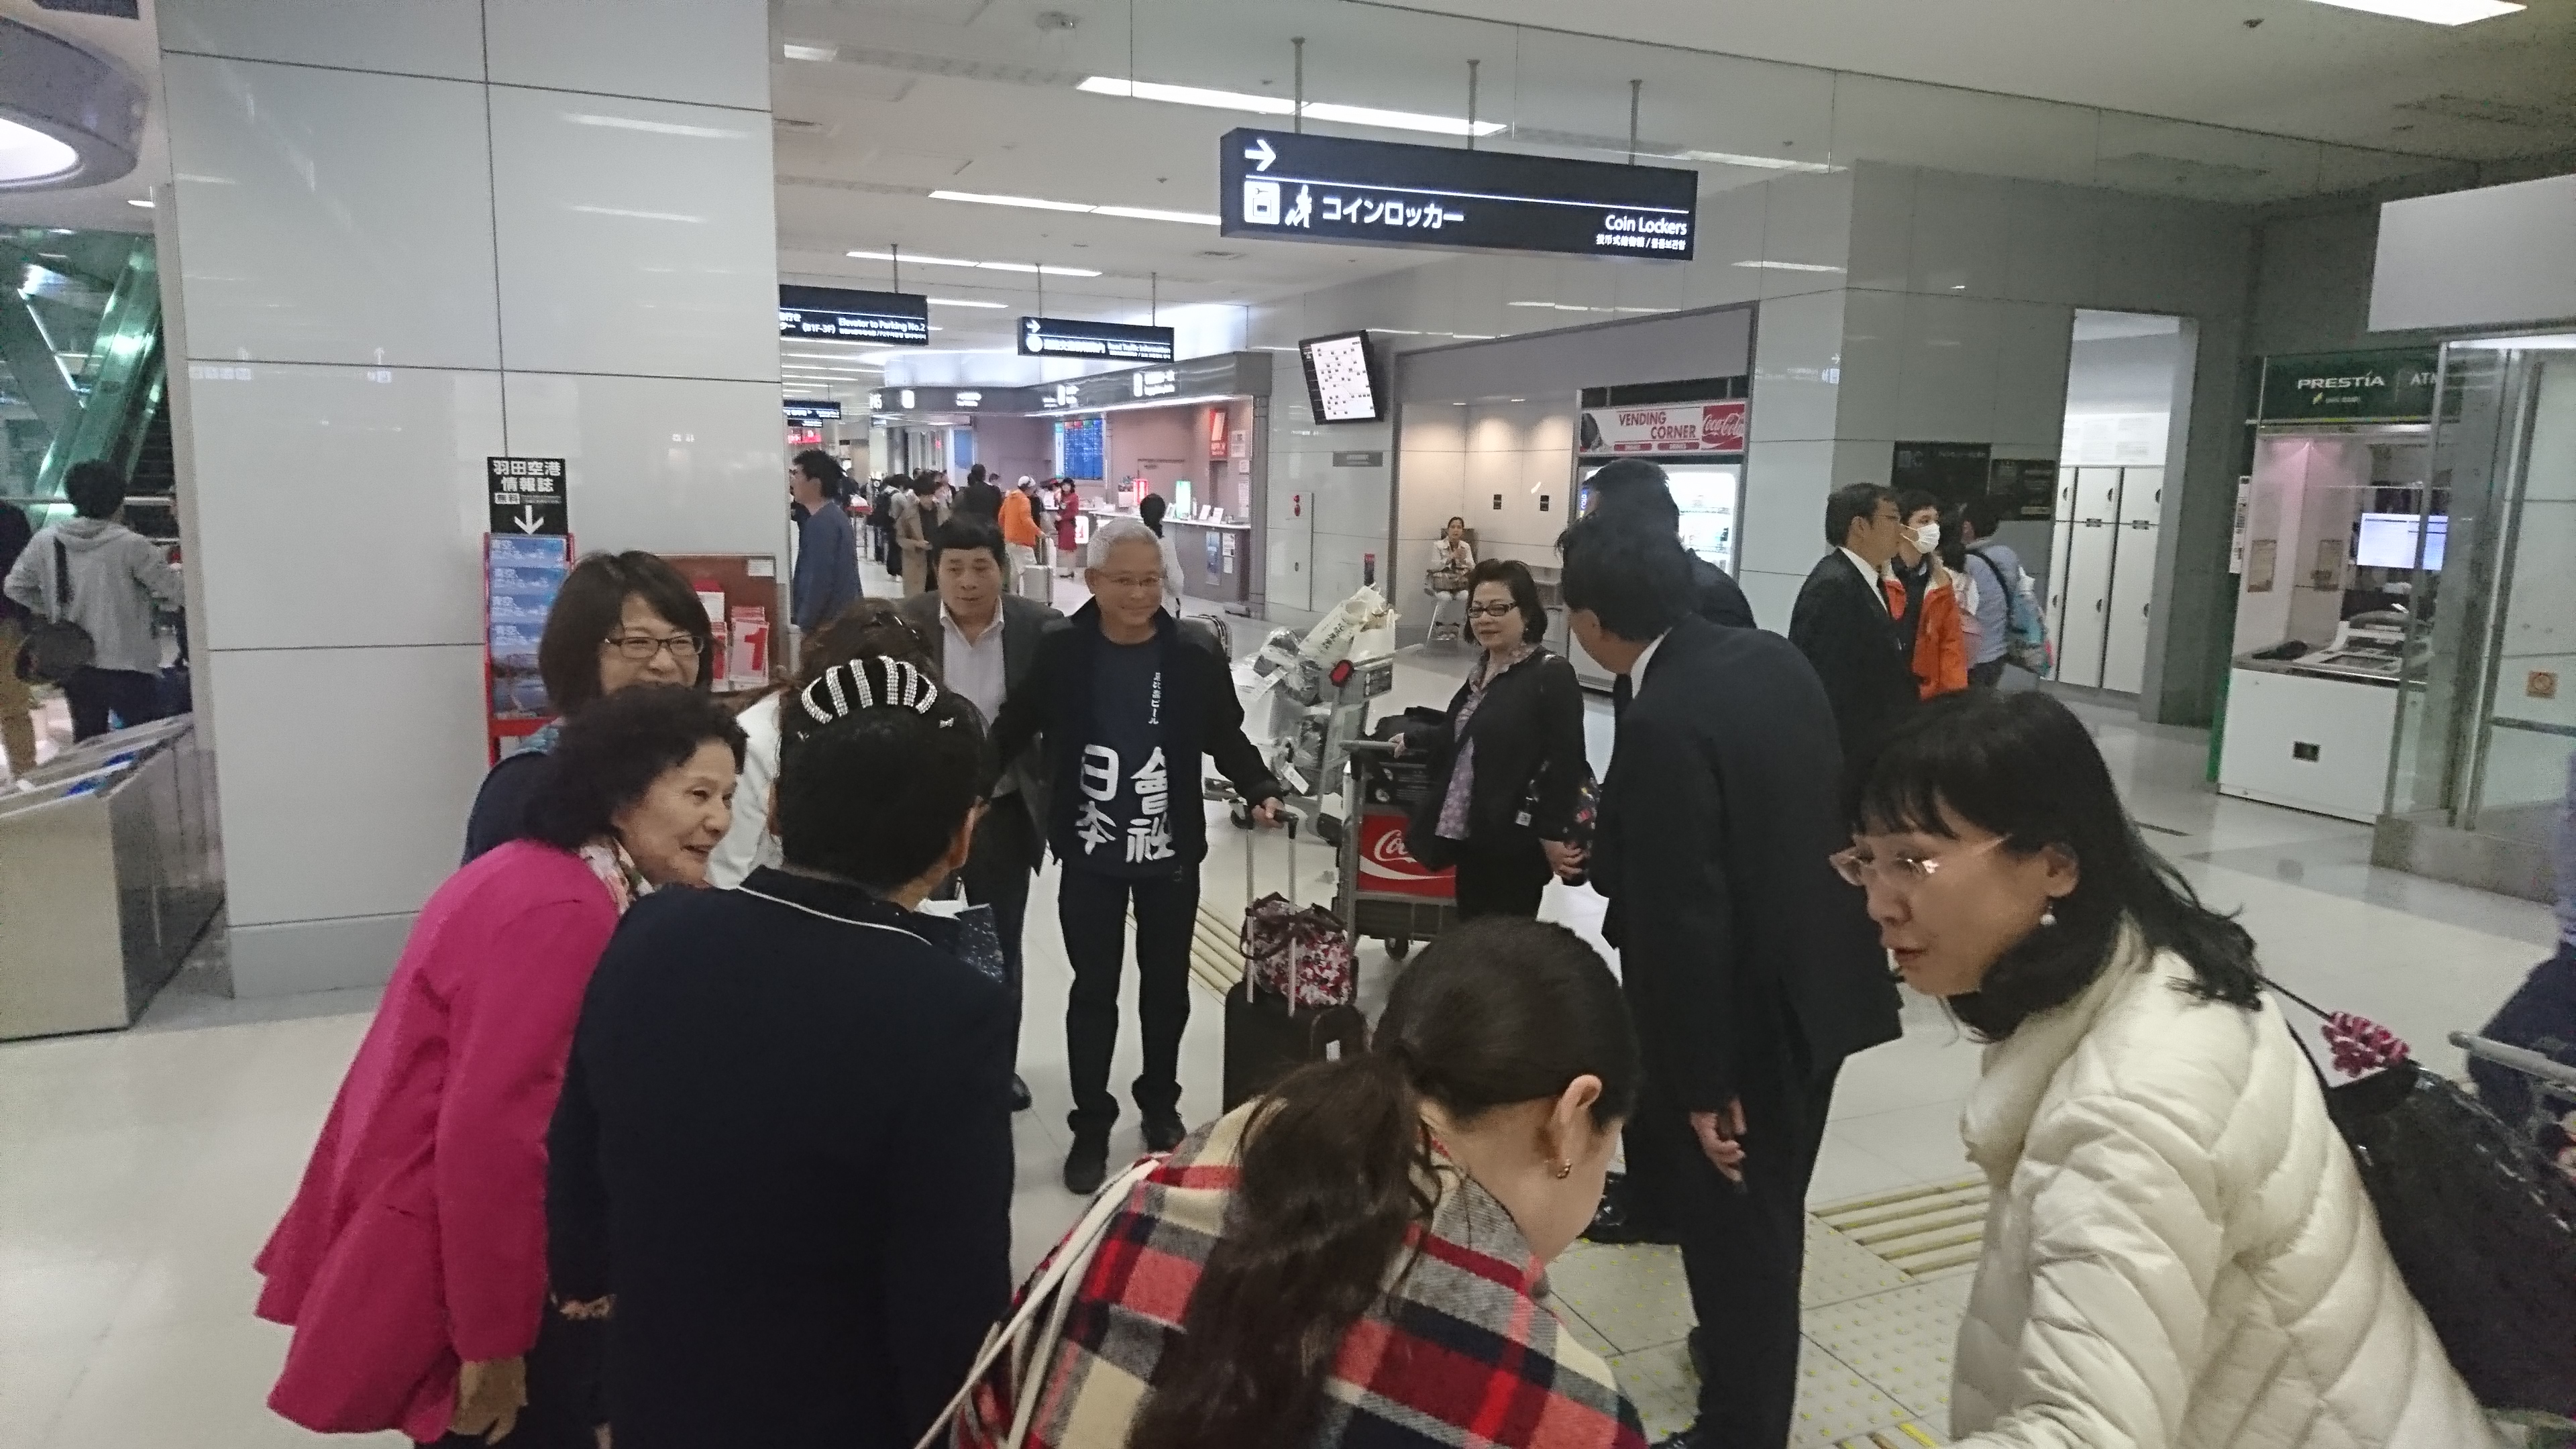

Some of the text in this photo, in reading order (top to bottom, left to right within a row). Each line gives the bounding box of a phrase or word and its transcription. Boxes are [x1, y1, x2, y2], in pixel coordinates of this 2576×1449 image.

[1322, 197, 1464, 229] コインロッカー
[1605, 214, 1687, 235] Coin Lockers
[839, 317, 868, 328] Elevator
[870, 320, 878, 329] to
[879, 321, 907, 332] Parking
[908, 323, 926, 332] No.2
[1619, 412, 1667, 426] VENDING
[1650, 425, 1697, 439] CORNER
[493, 460, 561, 476] 羽田空港
[501, 476, 554, 492] 情報誌
